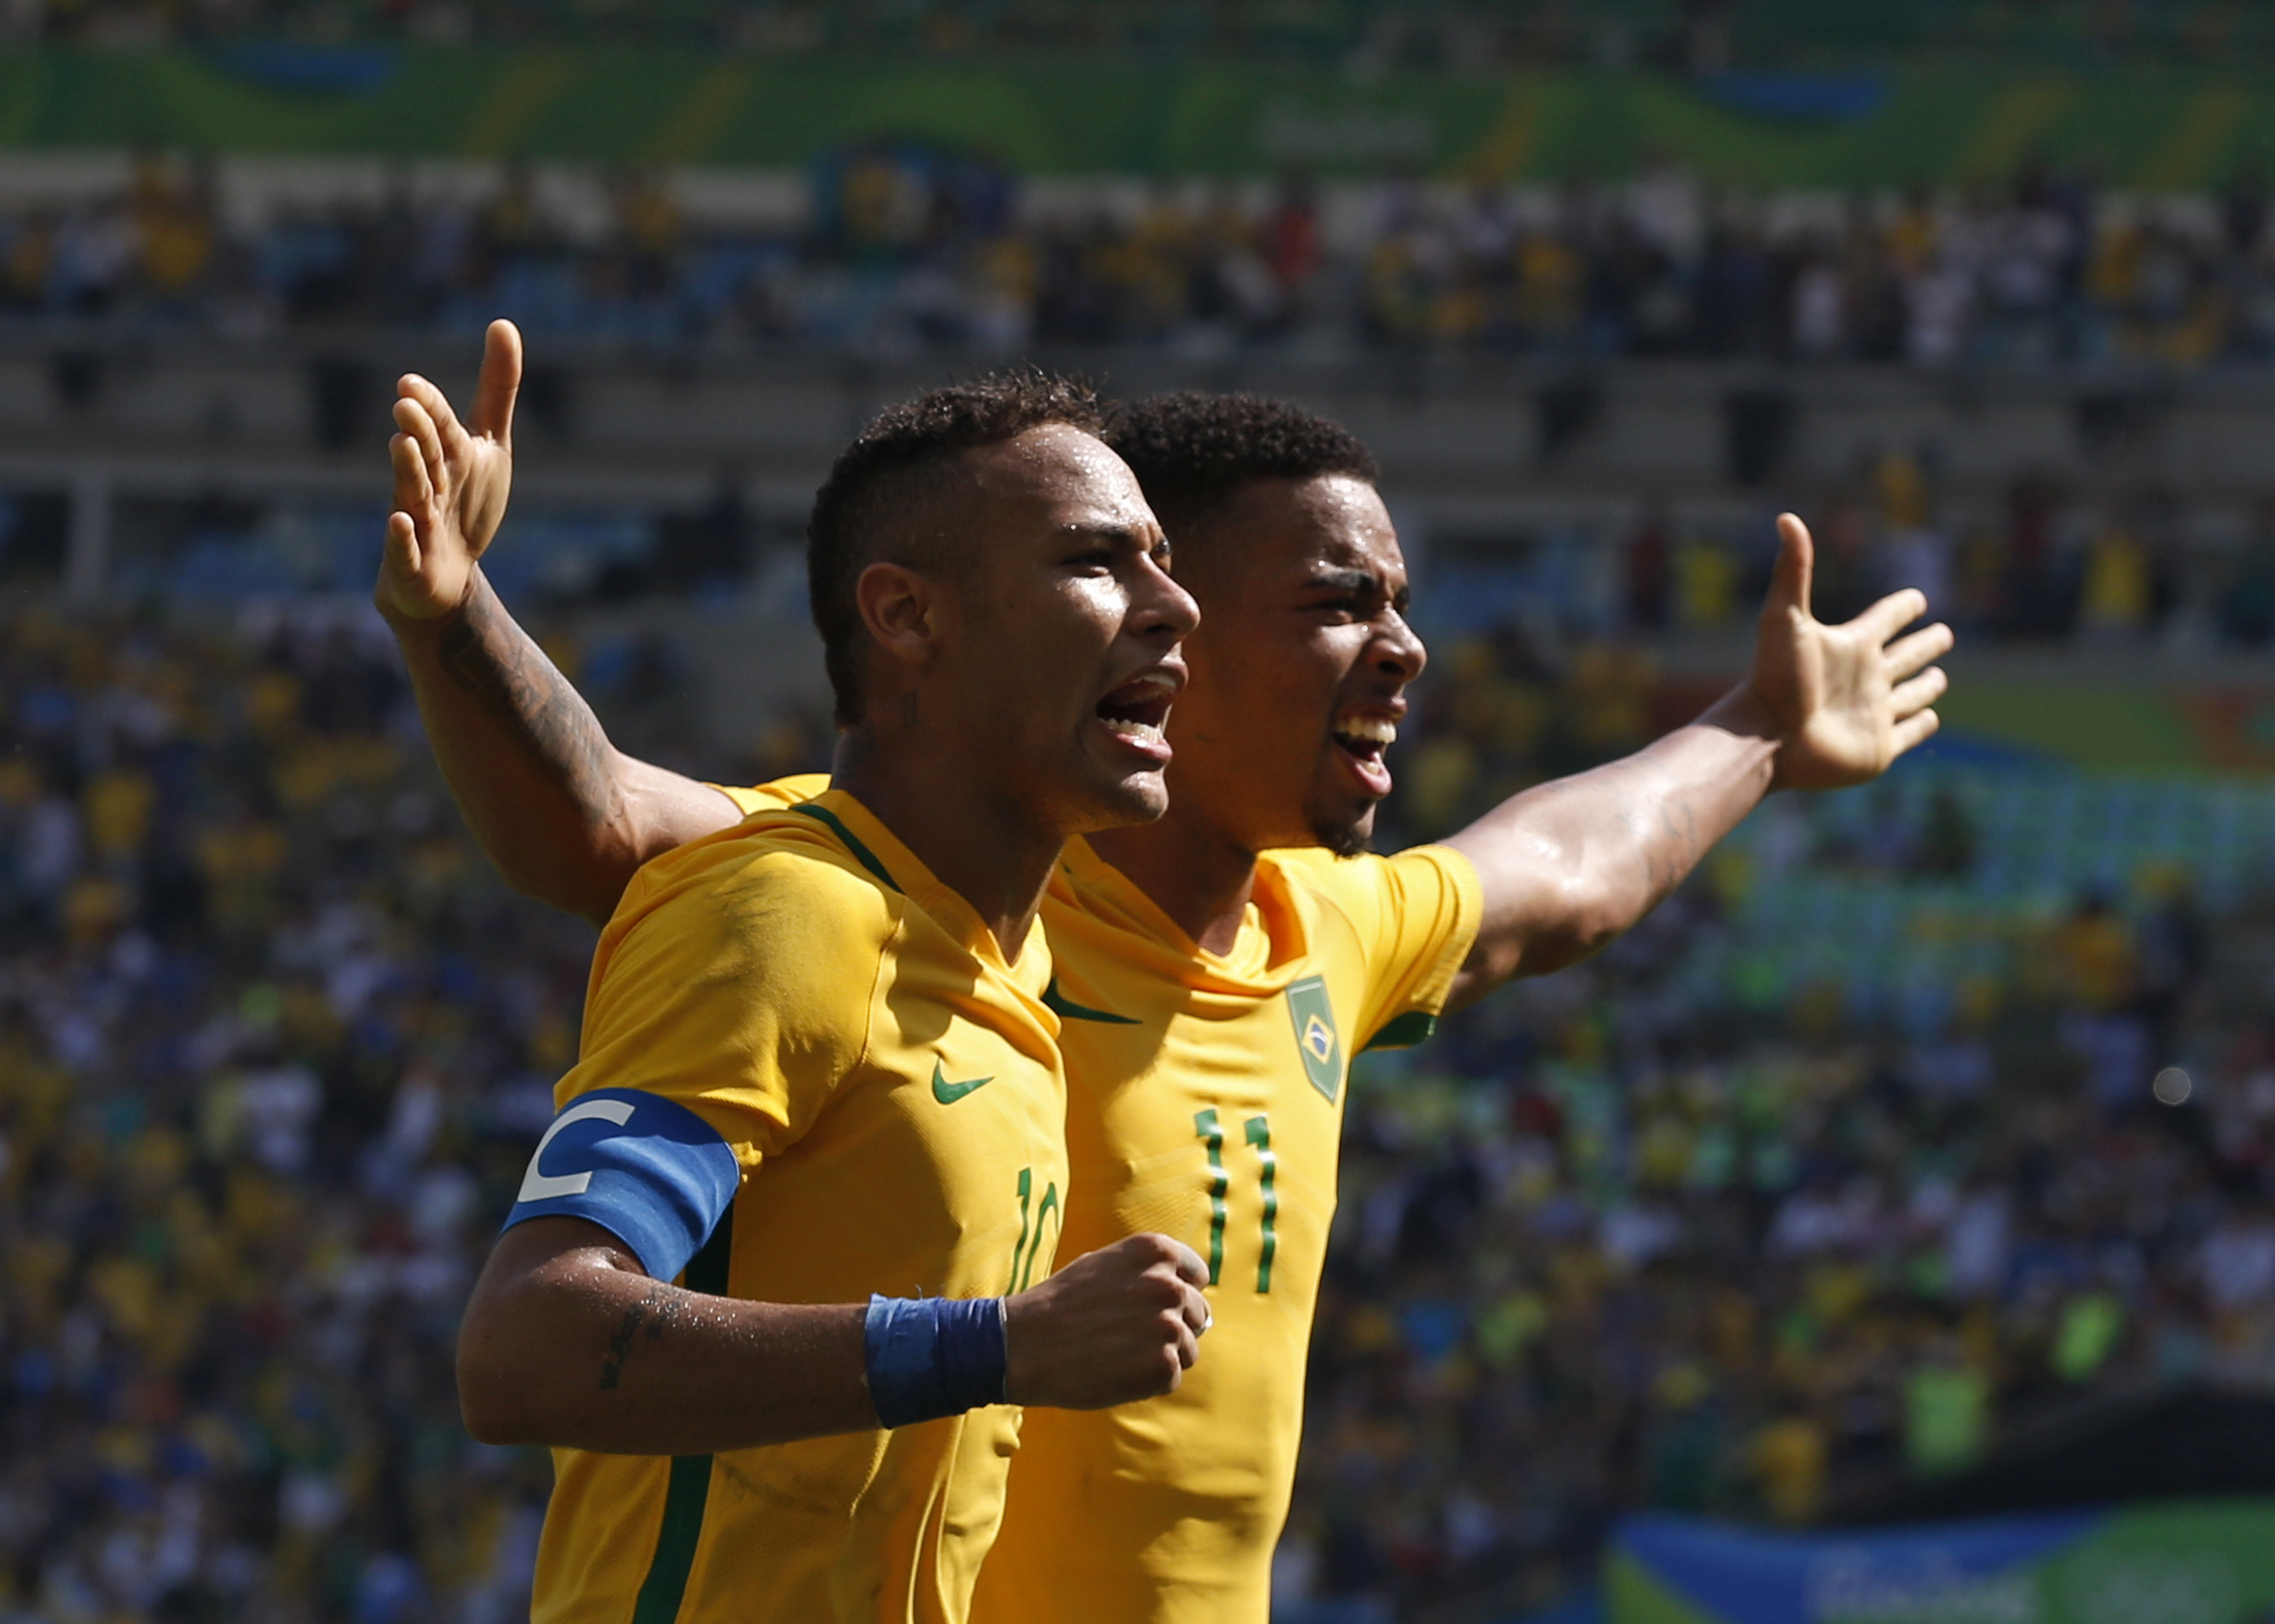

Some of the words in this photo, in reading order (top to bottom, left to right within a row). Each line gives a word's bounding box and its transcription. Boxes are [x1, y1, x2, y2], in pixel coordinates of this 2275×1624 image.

[518, 1099, 635, 1203] C
[1194, 1108, 1277, 1293] 11
[1005, 1166, 1059, 1295] 10
